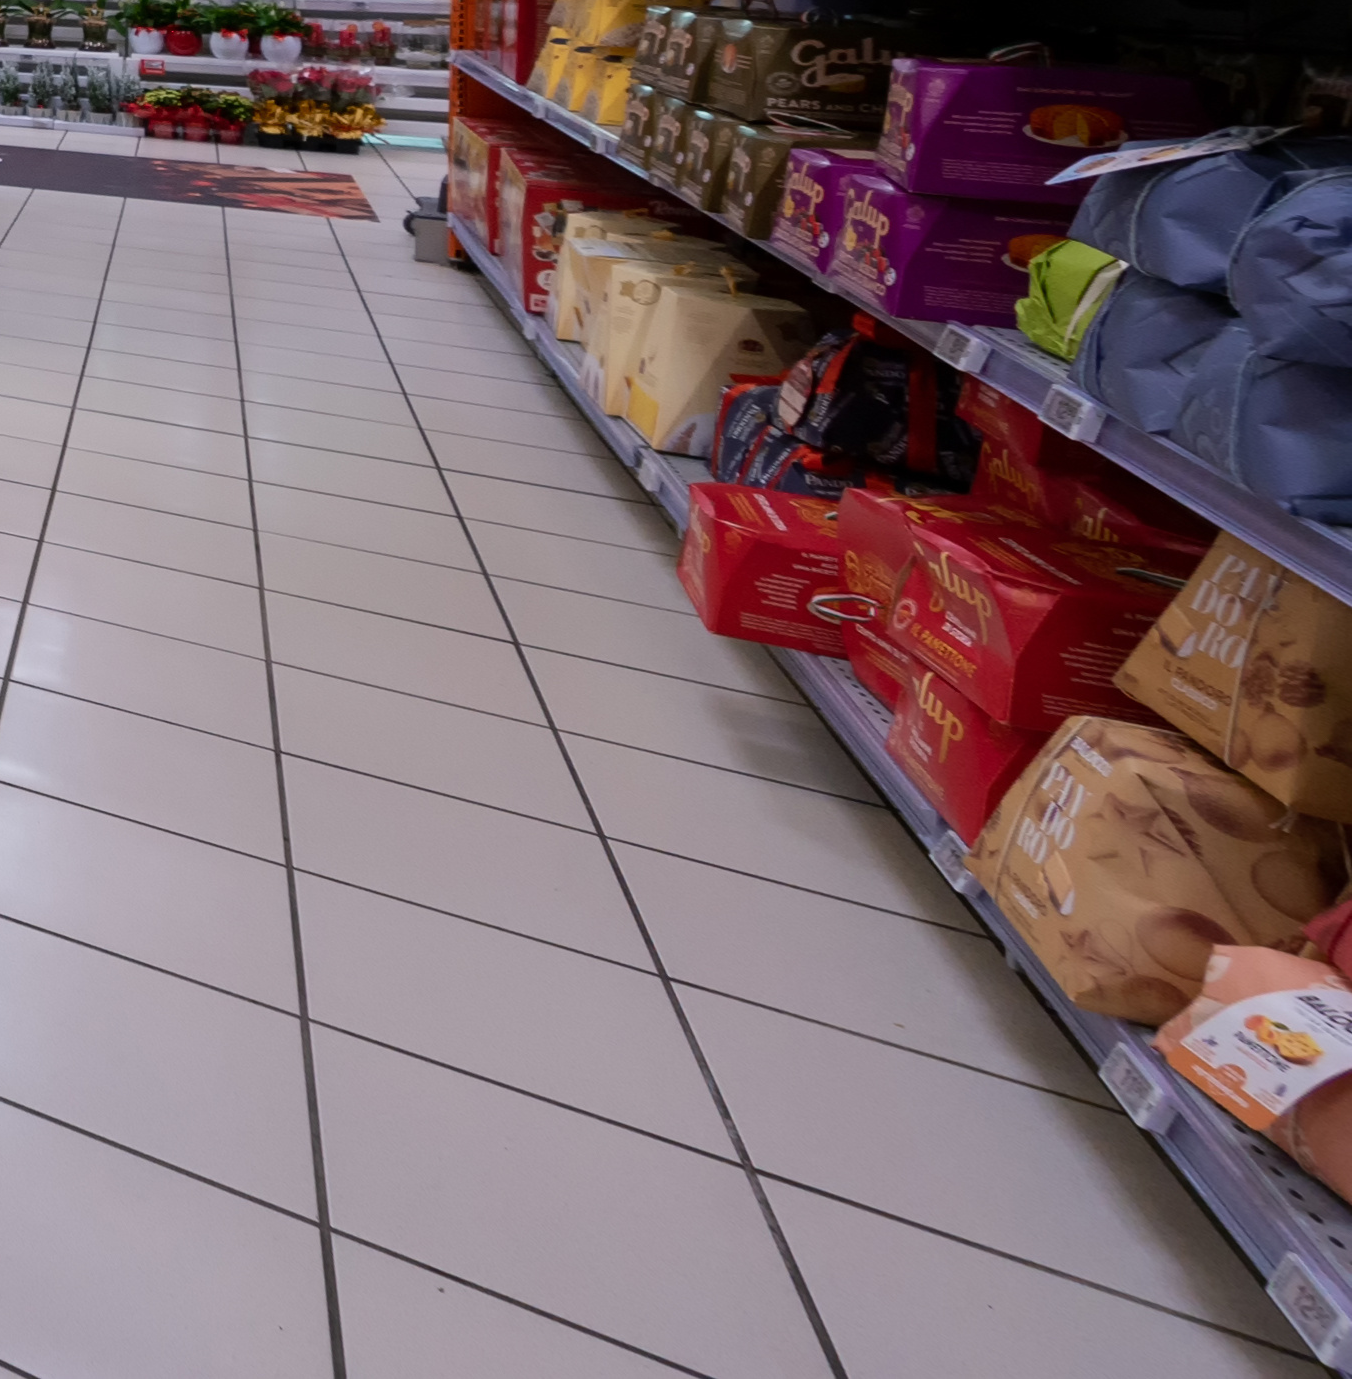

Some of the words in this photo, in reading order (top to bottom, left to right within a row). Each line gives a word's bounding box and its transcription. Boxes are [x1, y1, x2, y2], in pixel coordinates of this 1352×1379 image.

[767, 97, 821, 110] PEARS
[1191, 580, 1243, 628] DO
[921, 634, 977, 679] PANETTONE
[1197, 622, 1248, 669] RO
[1174, 666, 1231, 706] PANDORO
